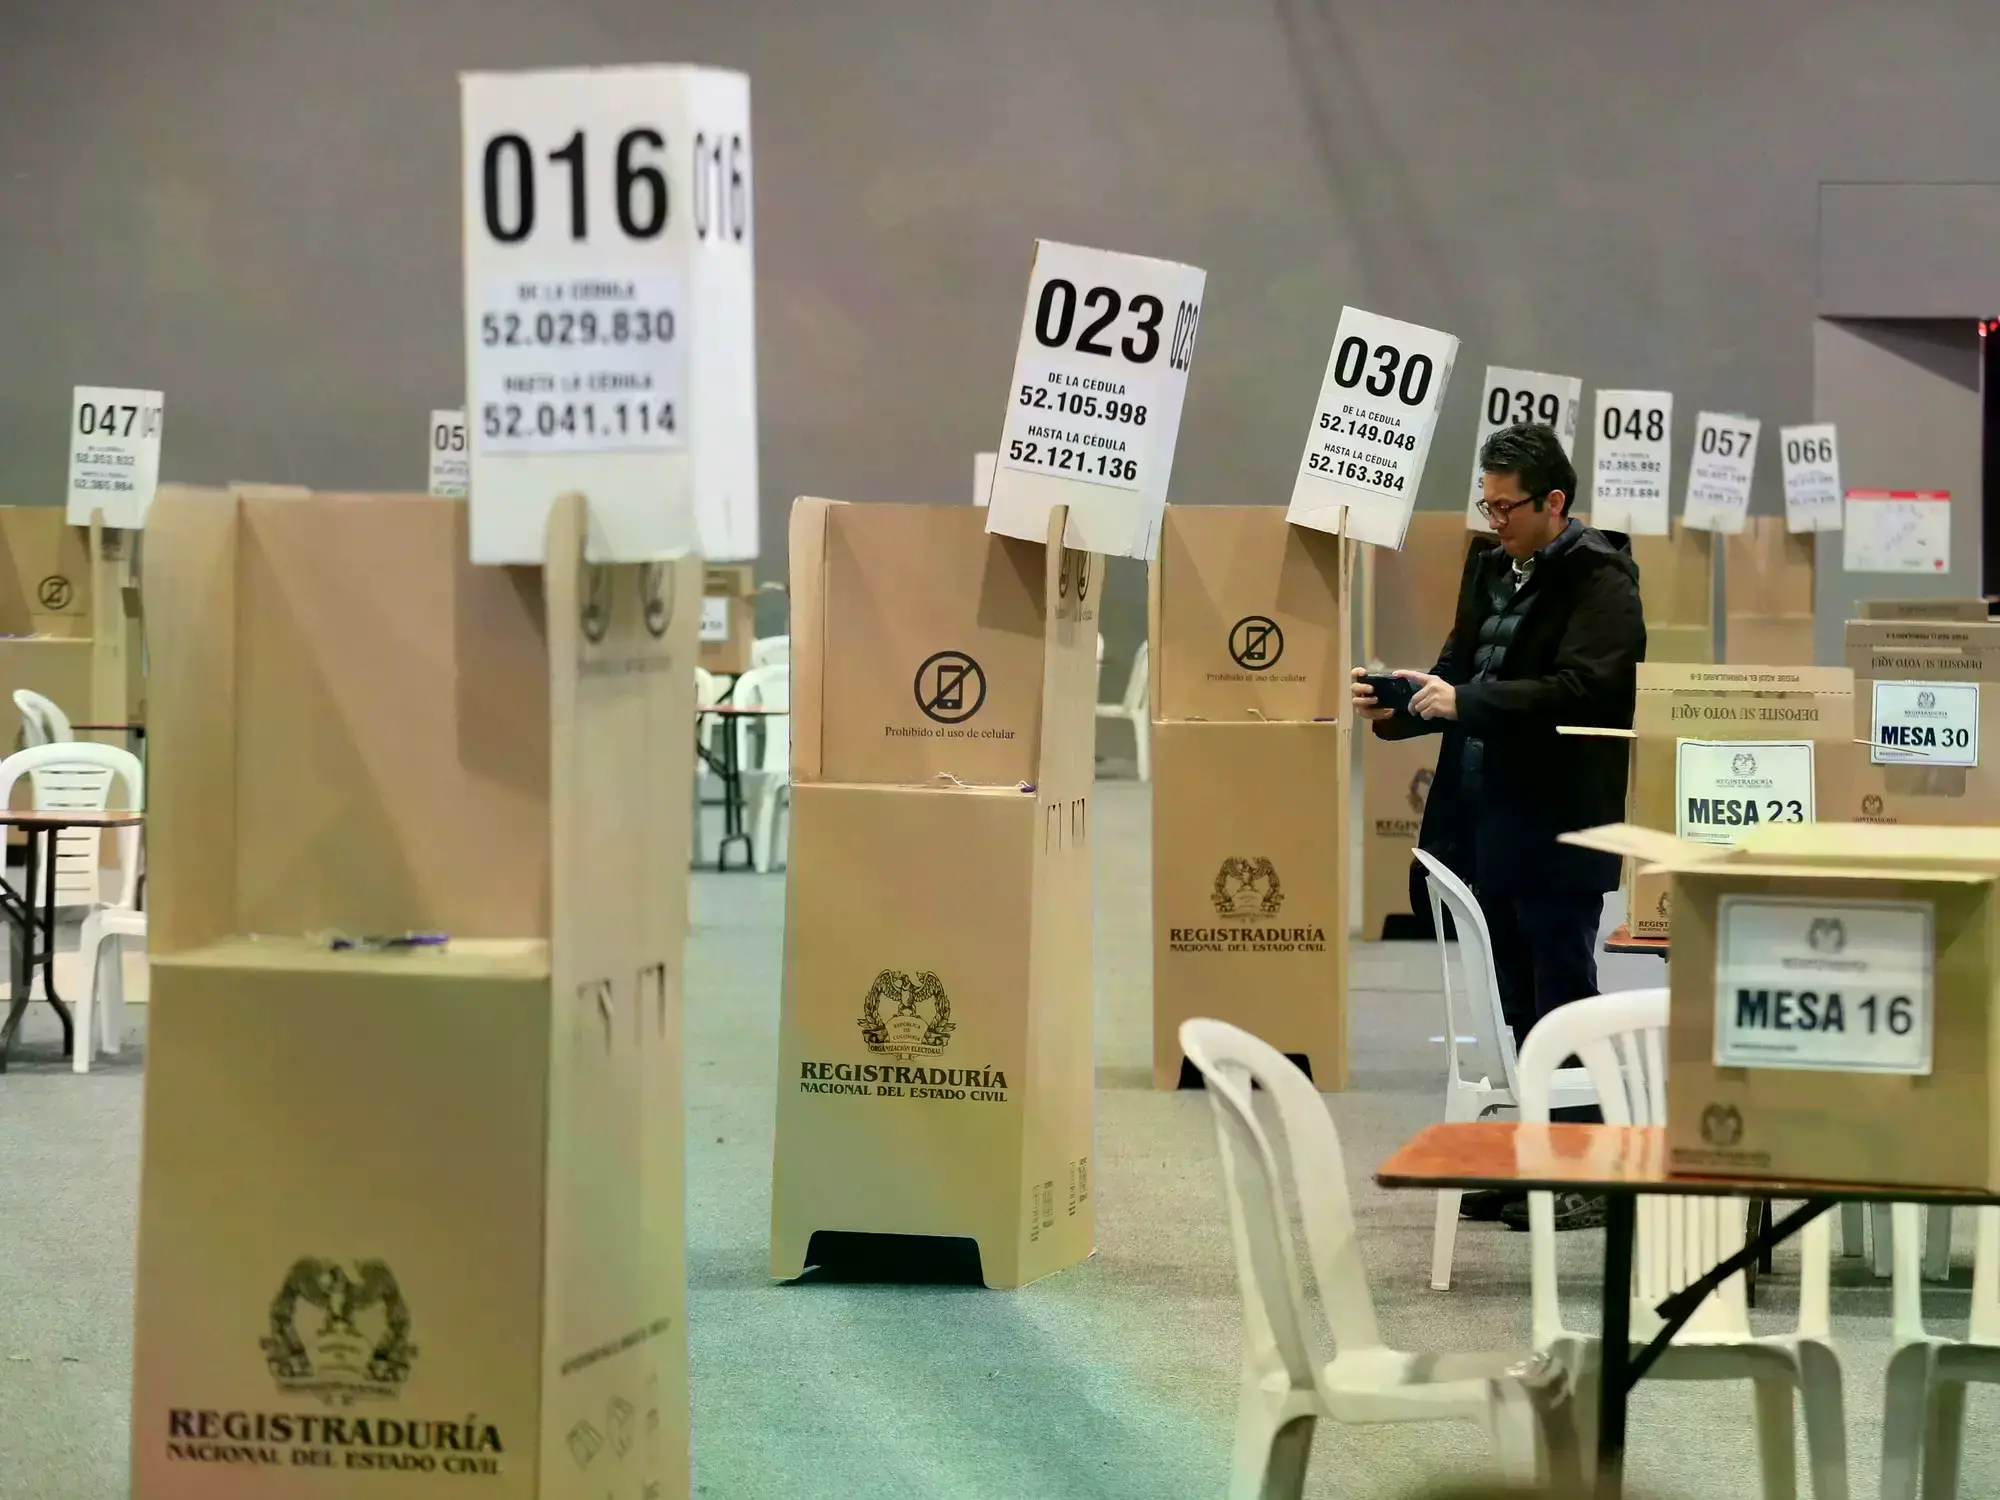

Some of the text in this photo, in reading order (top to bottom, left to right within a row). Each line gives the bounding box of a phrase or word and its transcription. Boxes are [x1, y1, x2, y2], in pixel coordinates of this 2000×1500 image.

[483, 128, 669, 244] 016
[482, 310, 675, 347] 52.029.830
[1035, 278, 1164, 364] 023
[1170, 300, 1198, 372] 023
[1048, 372, 1062, 384] DE
[1066, 375, 1079, 387] LA
[1334, 336, 1433, 406] 030
[80, 402, 138, 437] 047
[484, 402, 676, 438] 52.041.114
[1019, 385, 1148, 426] 52.105.998
[1342, 405, 1353, 415] DE
[1356, 408, 1366, 418] LA
[1487, 387, 1559, 427] 039
[436, 424, 469, 452] 05
[1028, 425, 1126, 452] HASTA LA CÉDULA
[1319, 413, 1416, 451] 52.149.048
[1603, 407, 1664, 441] 048
[1324, 443, 1350, 457] HASTA
[1353, 450, 1363, 460] LA
[1702, 428, 1752, 459] 057
[1788, 439, 1832, 464] 066
[1009, 440, 1138, 481] 52.121.136
[1308, 453, 1405, 491] 52.163.384
[1896, 658, 1921, 668] VOTO
[1671, 704, 1819, 721] DEPOSITE SU VOTO AQUÍ
[885, 726, 1015, 739] Prohibido el uso de celular
[1881, 726, 1969, 747] MESA 30
[1688, 798, 1803, 826] MESA 23
[1170, 924, 1326, 942] REGISTRADURÍA
[1170, 943, 1326, 952] NACIONAL DEL ESTADO CIVIL
[1736, 989, 1913, 1035] MESA 16
[871, 1044, 941, 1054] ORGANIZACIÓN ELECTORAL
[800, 1061, 1008, 1089] REGISTRADURÍA
[800, 1082, 1008, 1102] NACIONAL DEL ESTADO CIVIL
[168, 1407, 504, 1454] REGISTRADURÍA
[166, 1441, 502, 1476] NACIONAL DEL ESTADO CIVIL
